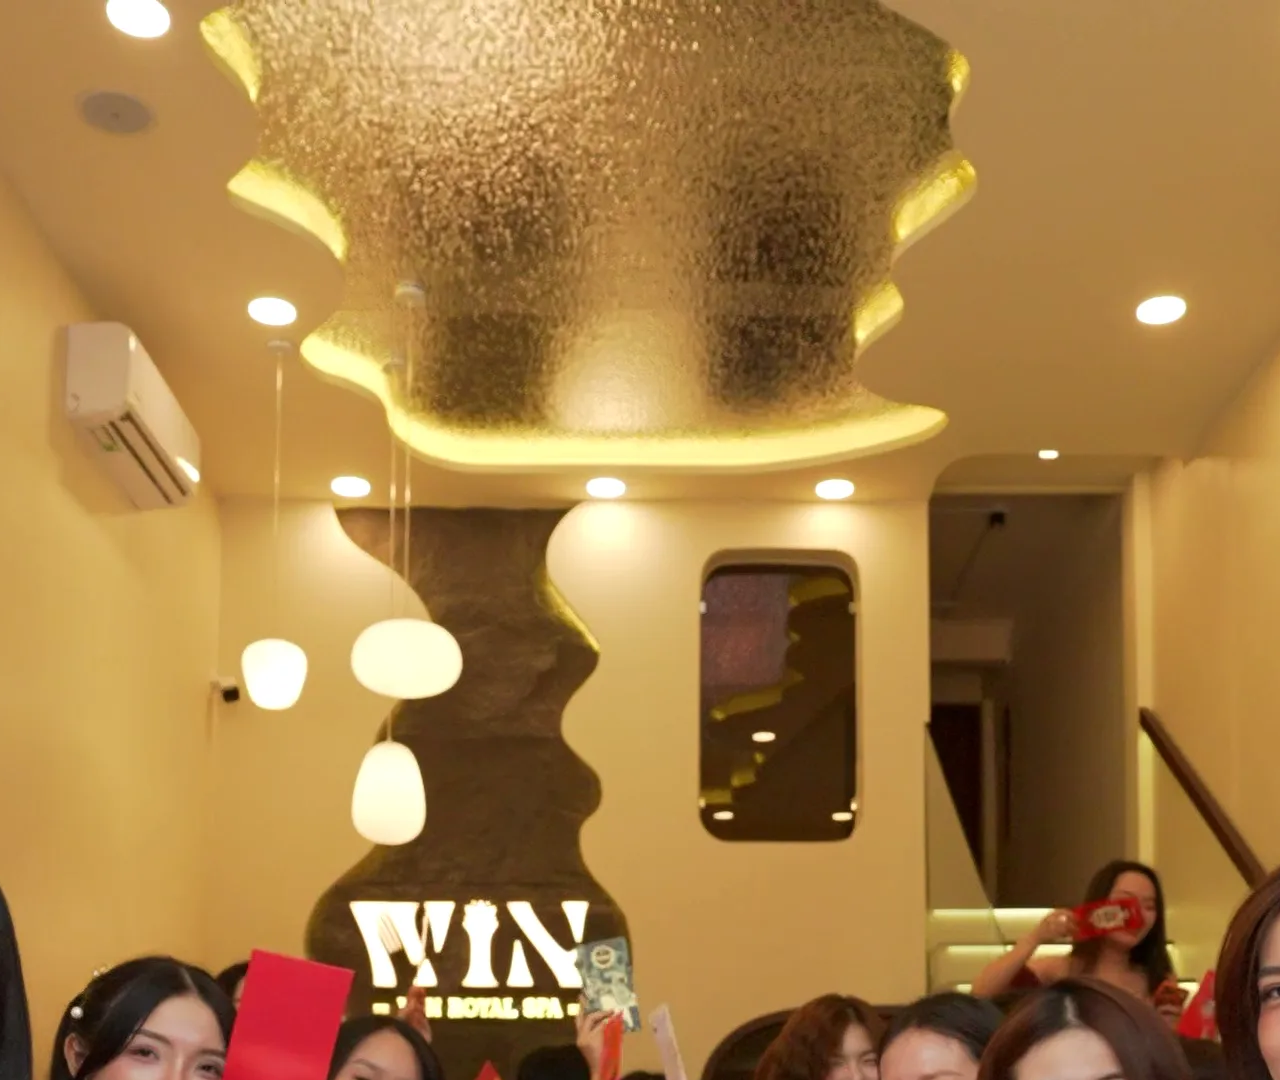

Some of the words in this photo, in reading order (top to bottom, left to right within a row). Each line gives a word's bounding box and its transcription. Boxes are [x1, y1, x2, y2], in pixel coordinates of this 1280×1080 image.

[350, 900, 588, 988] WIN
[447, 997, 519, 1019] ROYAL
[522, 997, 564, 1019] SPA
